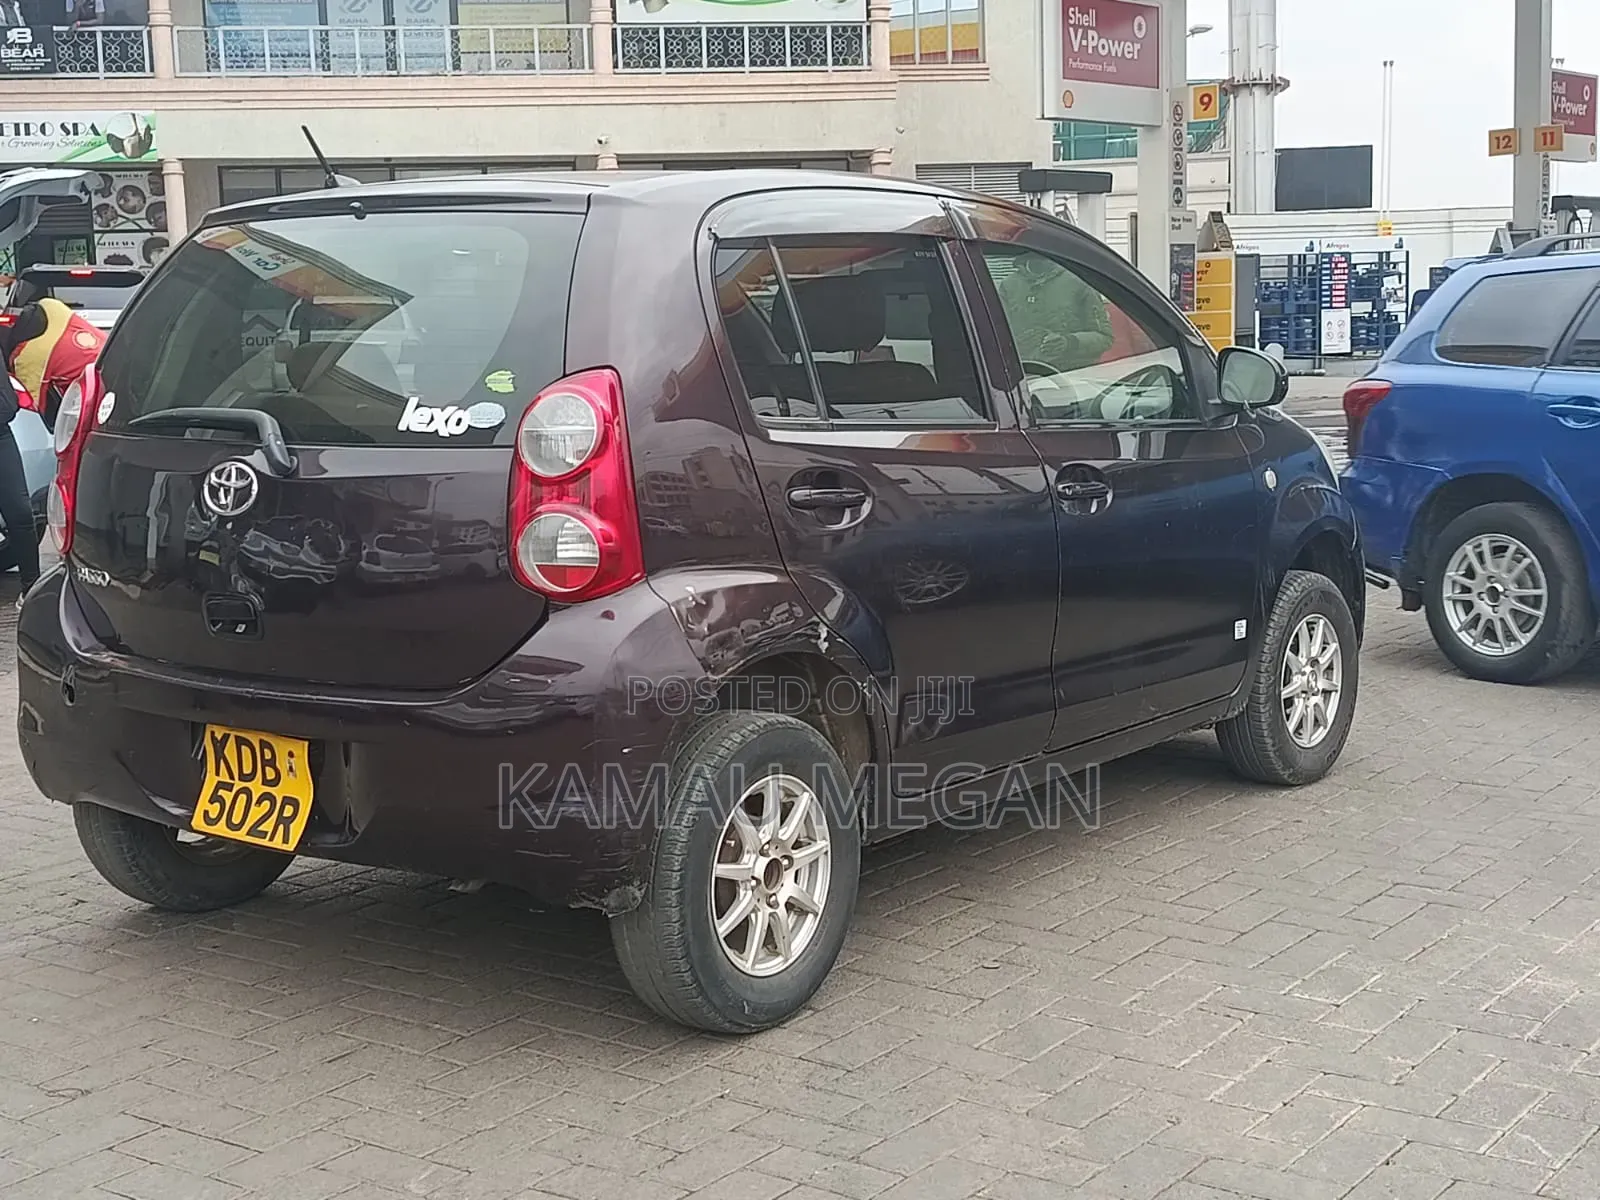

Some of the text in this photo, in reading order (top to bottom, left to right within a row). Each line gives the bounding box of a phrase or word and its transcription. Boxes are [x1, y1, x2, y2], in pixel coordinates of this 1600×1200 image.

[1068, 7, 1096, 27] Shell
[1, 48, 45, 58] BEAR
[1069, 28, 1141, 59] V-Power
[1199, 92, 1213, 112] 9
[1552, 95, 1588, 116] V-Power
[0, 121, 101, 137] ETRO SPA
[1541, 131, 1555, 146] 11
[1495, 135, 1513, 150] 12
[210, 730, 282, 788] KDB
[203, 780, 301, 845] 502R
